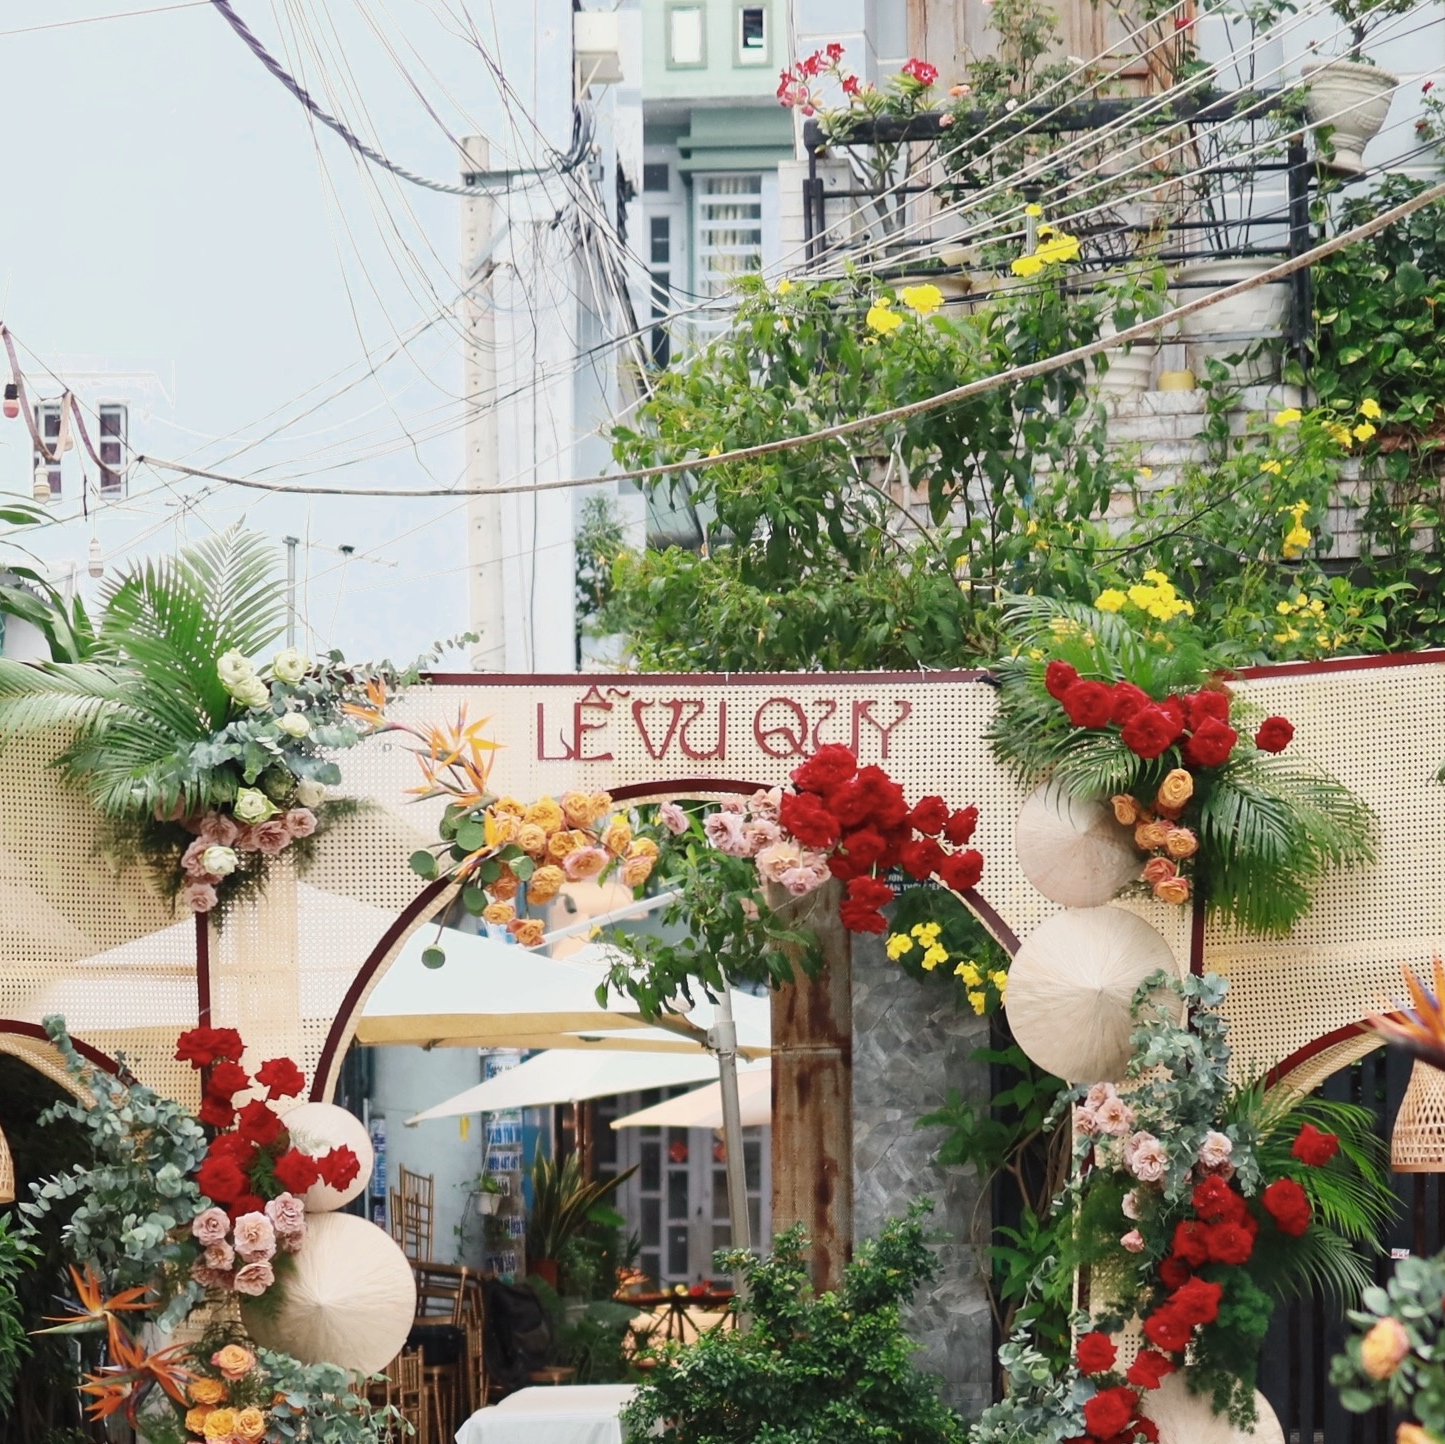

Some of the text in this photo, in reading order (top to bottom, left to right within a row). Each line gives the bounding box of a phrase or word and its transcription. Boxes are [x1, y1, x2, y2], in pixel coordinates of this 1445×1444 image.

[537, 685, 912, 760] LỄ VU QUY
